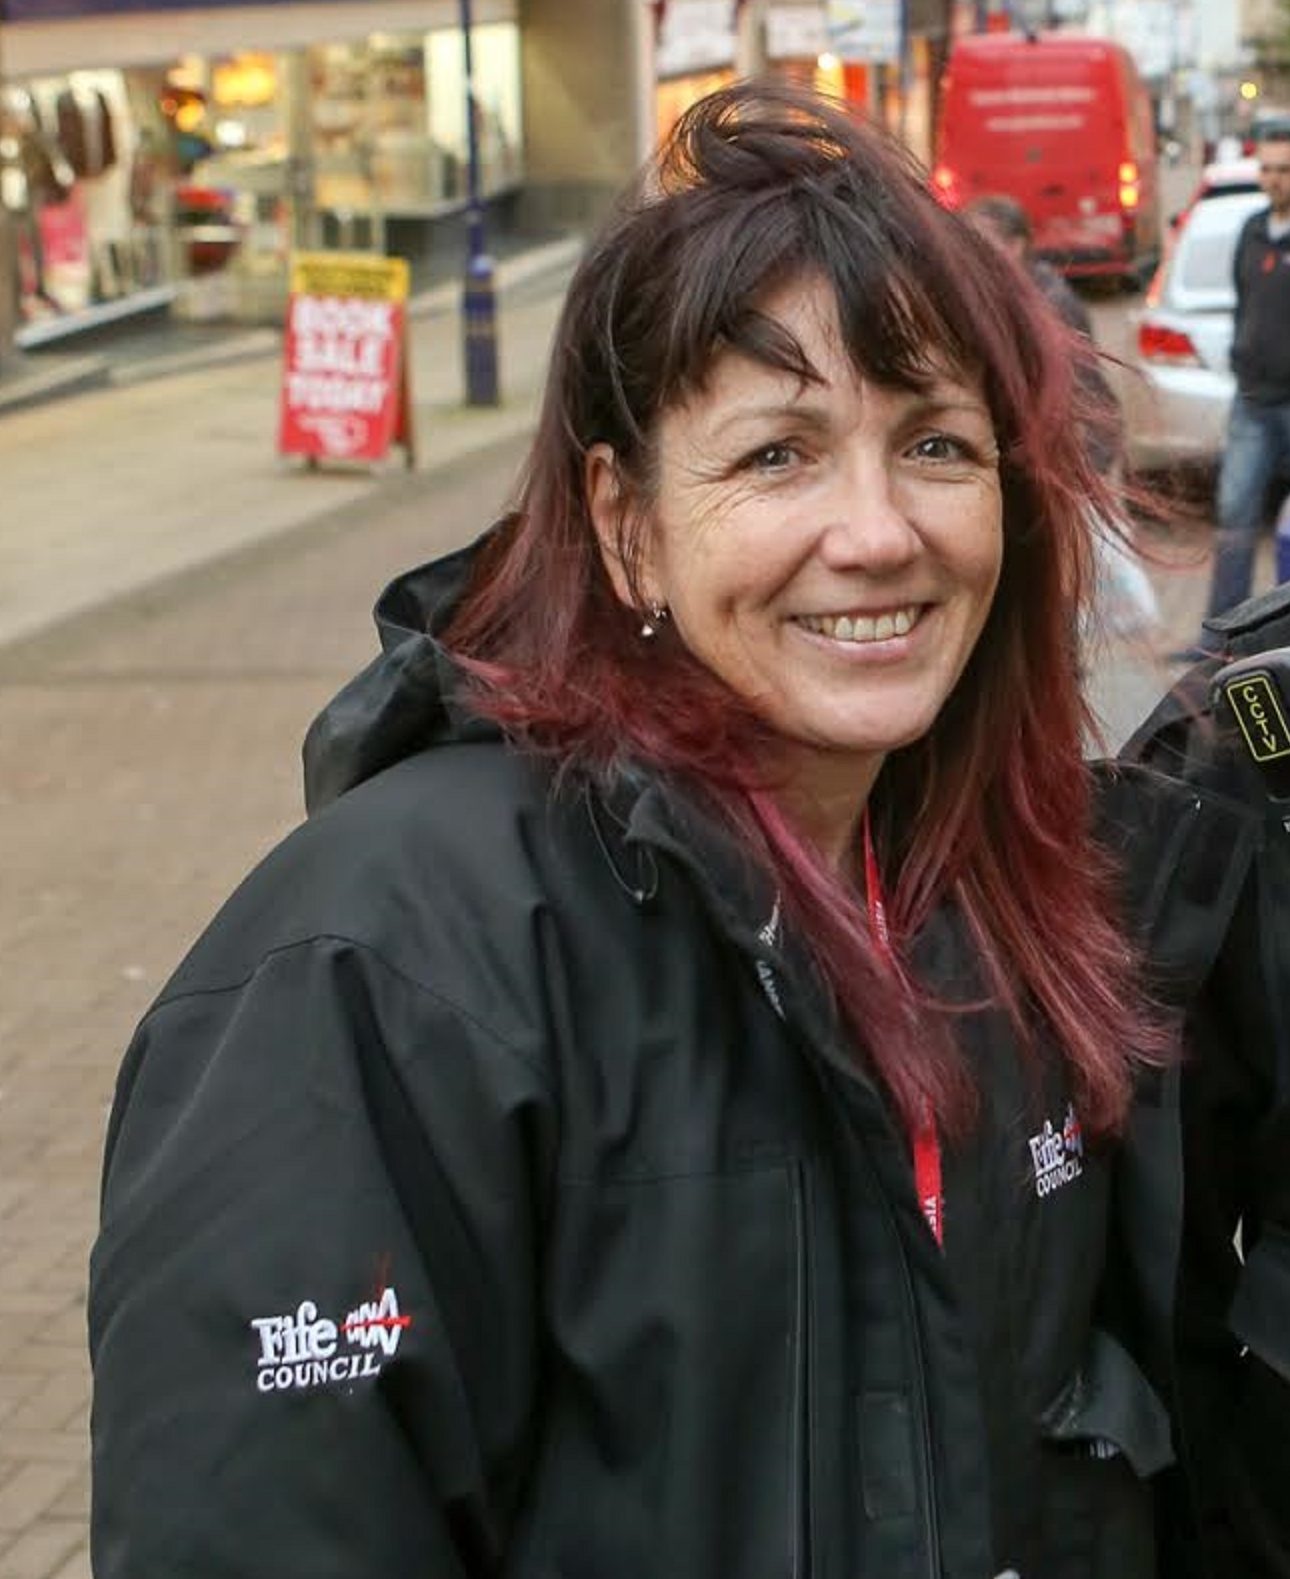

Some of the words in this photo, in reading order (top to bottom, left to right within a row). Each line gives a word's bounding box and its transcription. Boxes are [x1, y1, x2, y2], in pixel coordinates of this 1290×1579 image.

[293, 298, 394, 338] BOOK
[295, 334, 385, 374] SALE
[287, 374, 388, 412] TODAY
[1243, 687, 1277, 752] CCTV
[1029, 1120, 1065, 1177] Fife
[1036, 1159, 1083, 1197] COUNCIL
[251, 1301, 338, 1366] Fife
[257, 1353, 381, 1391] COUNCIL
